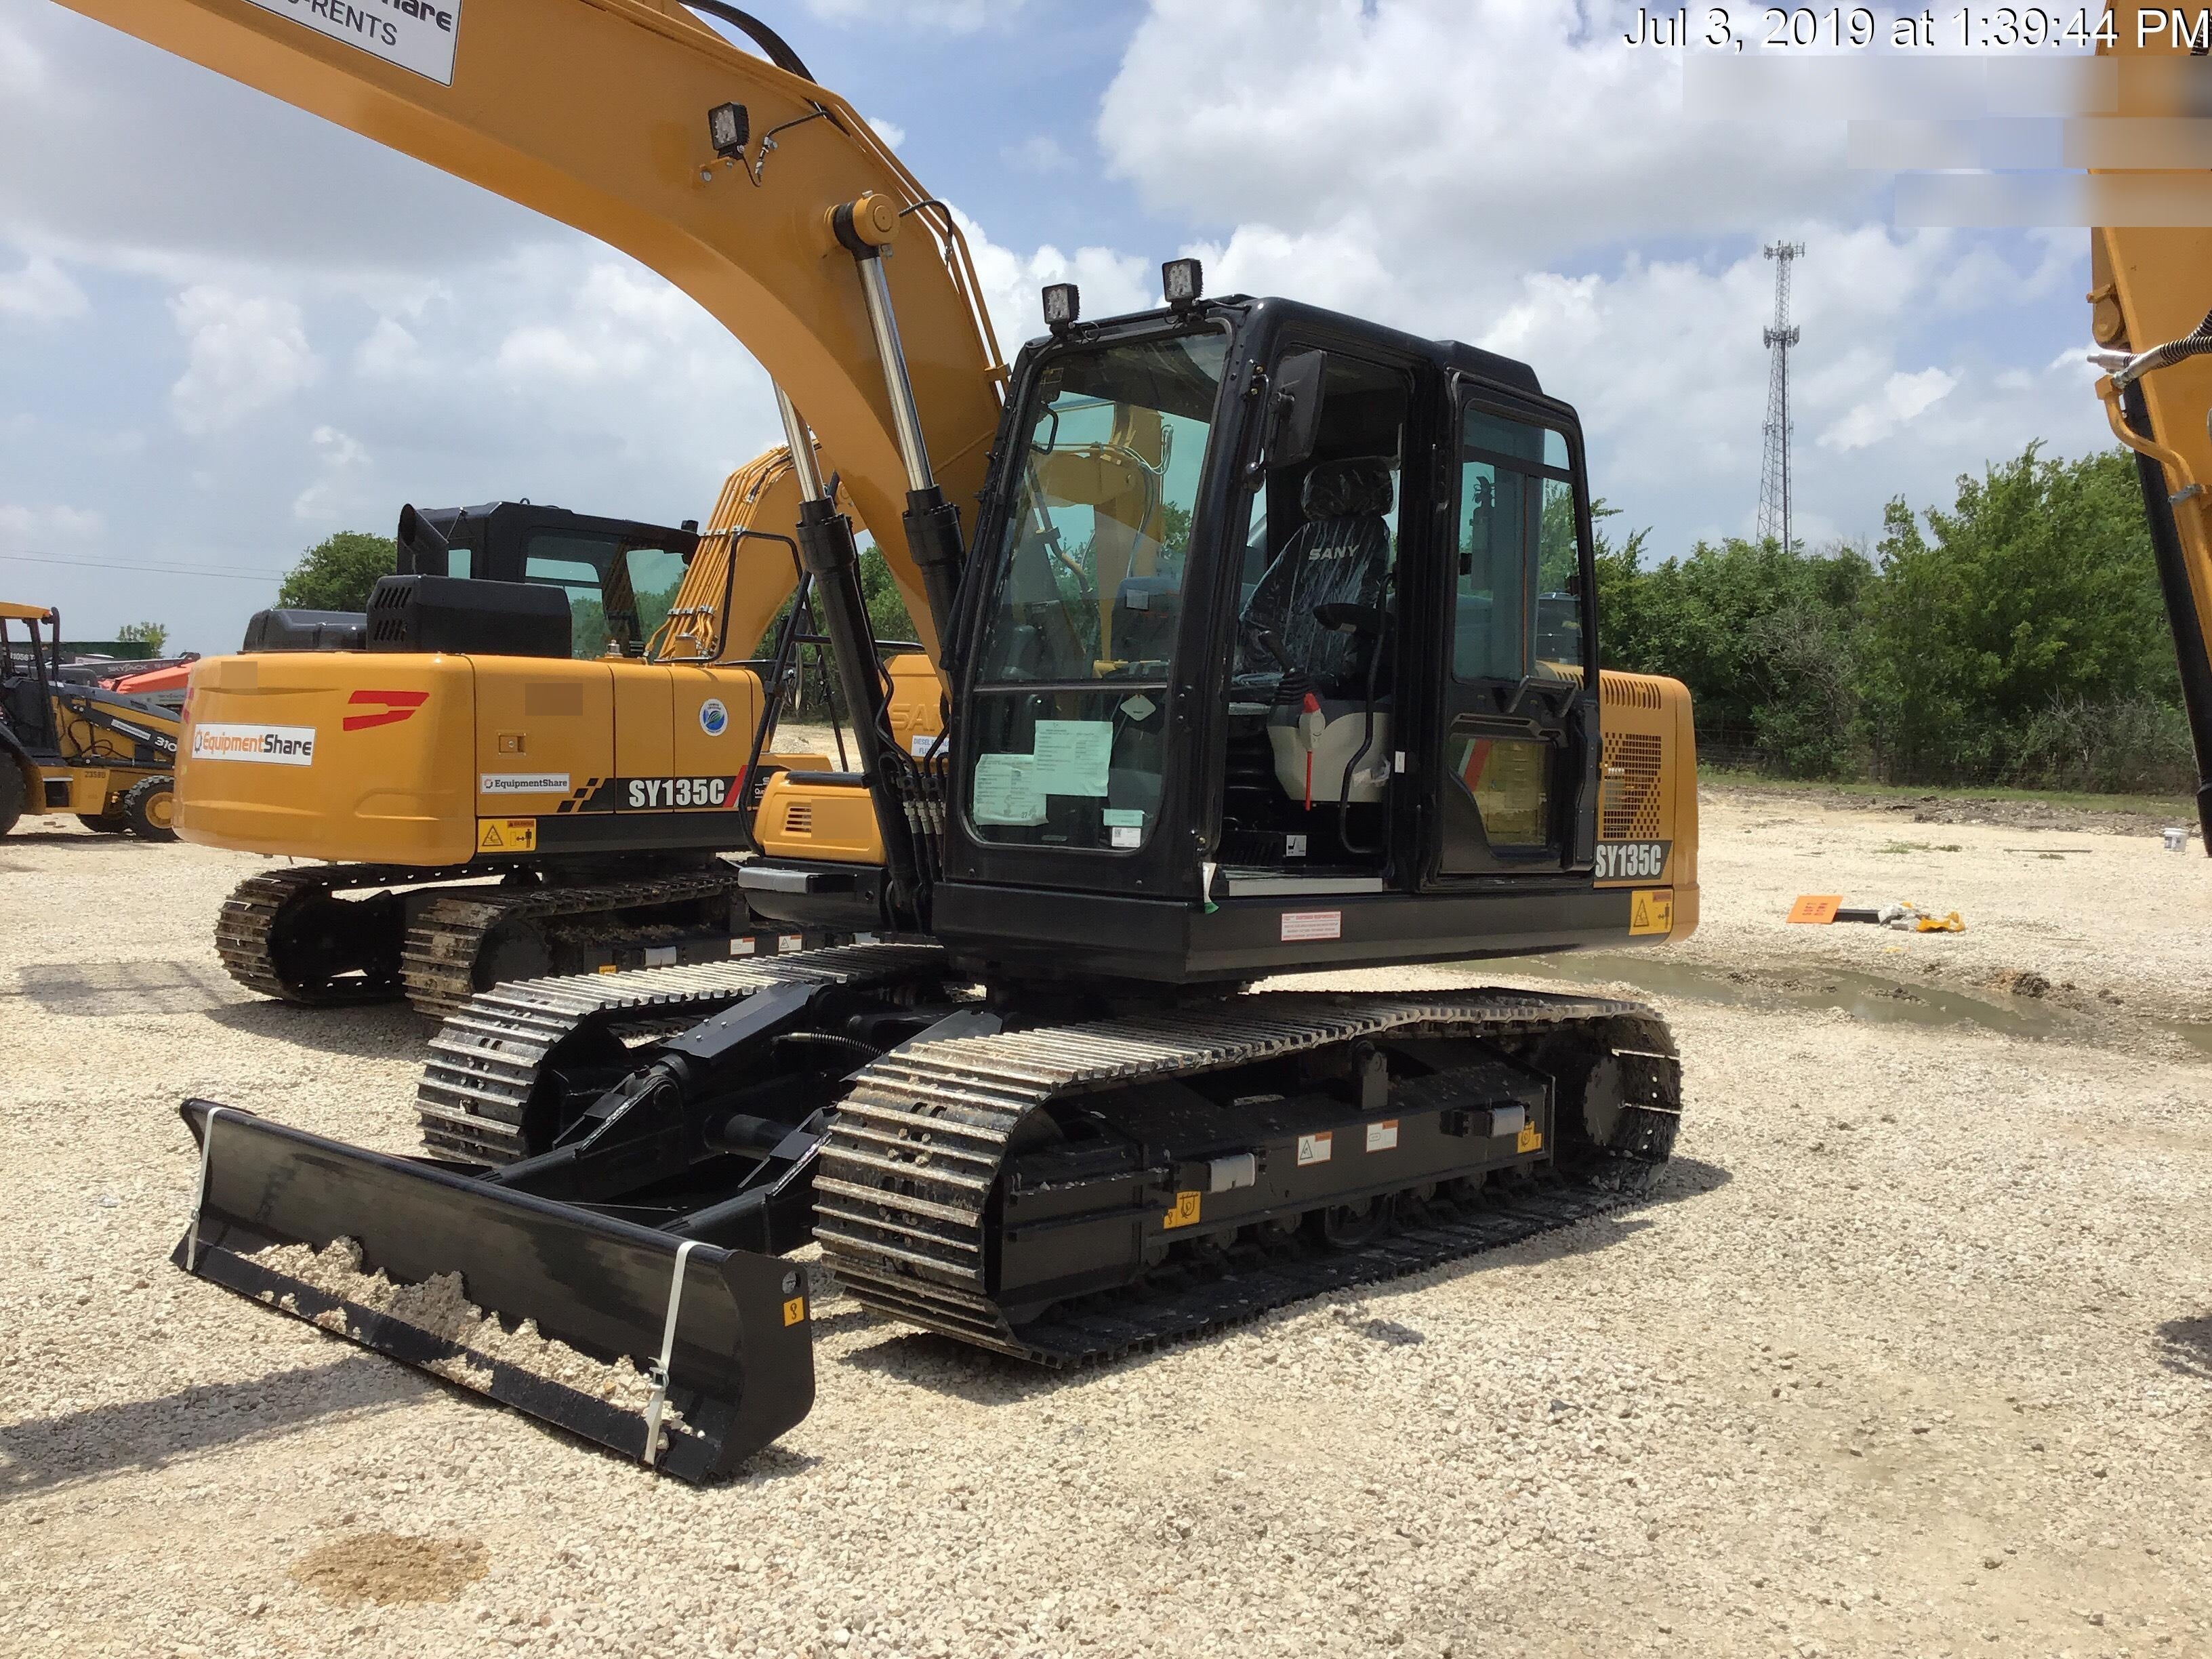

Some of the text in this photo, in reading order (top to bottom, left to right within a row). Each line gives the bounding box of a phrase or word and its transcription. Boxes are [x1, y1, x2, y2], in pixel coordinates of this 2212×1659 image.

[1309, 545, 1359, 560] SANY
[155, 736, 178, 752] 310
[203, 731, 312, 756] EquipmentShare
[914, 737, 930, 745] DIESEL
[495, 779, 567, 789] EquipmentShare
[628, 779, 725, 808] SY135C
[1595, 844, 1662, 878] SY135C
